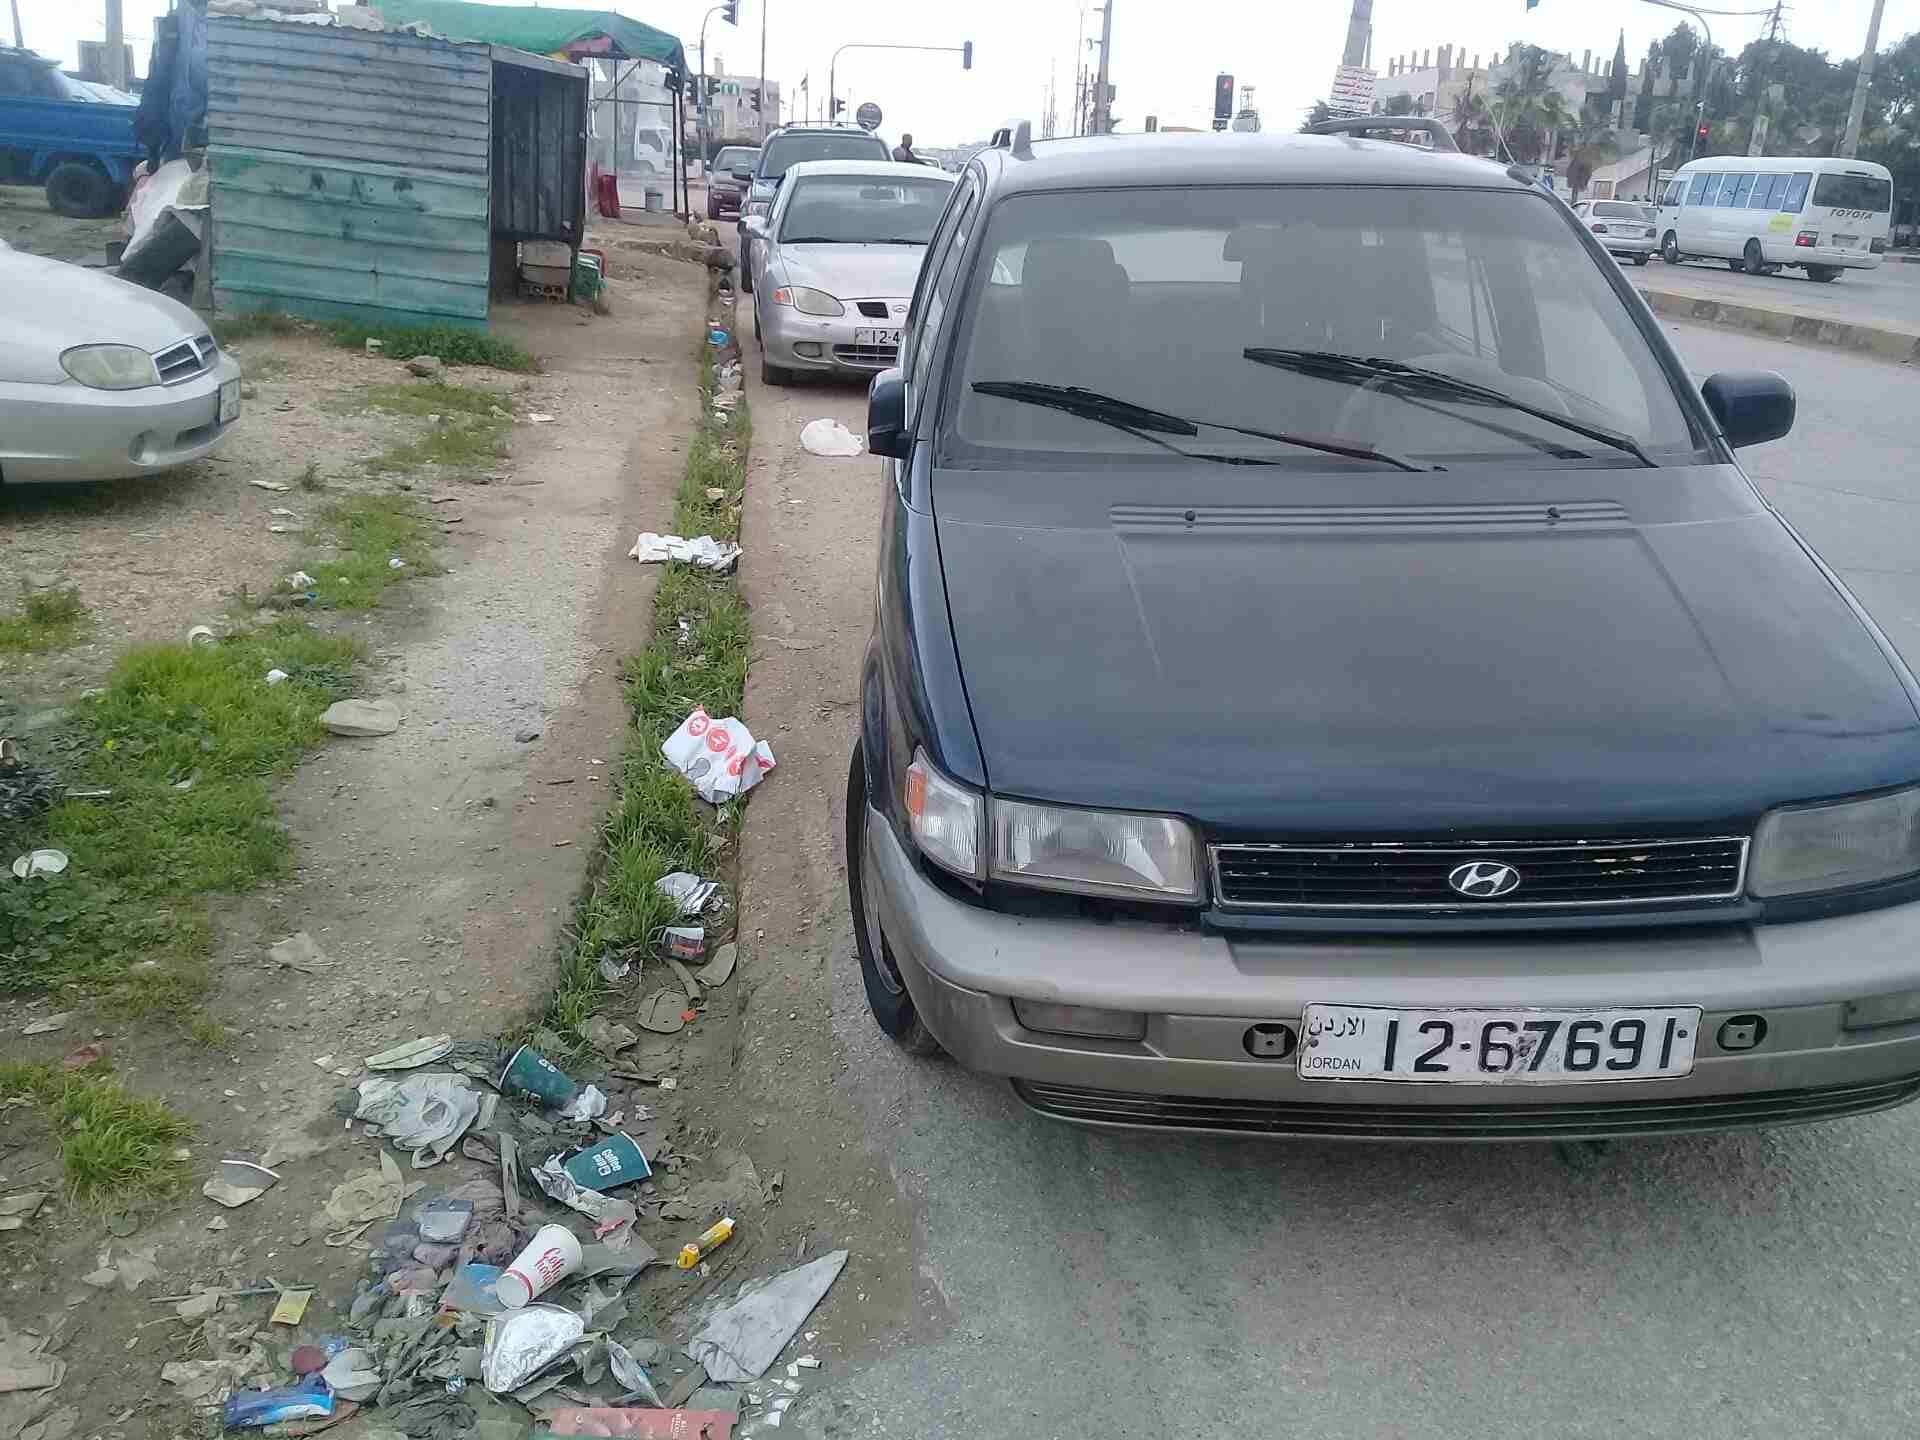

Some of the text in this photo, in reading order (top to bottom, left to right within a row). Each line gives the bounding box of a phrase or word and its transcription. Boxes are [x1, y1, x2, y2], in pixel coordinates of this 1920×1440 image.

[1830, 208, 1873, 220] TOYOTA
[1308, 1015, 1366, 1038] الاردن
[1304, 1055, 1361, 1070] JORDAN
